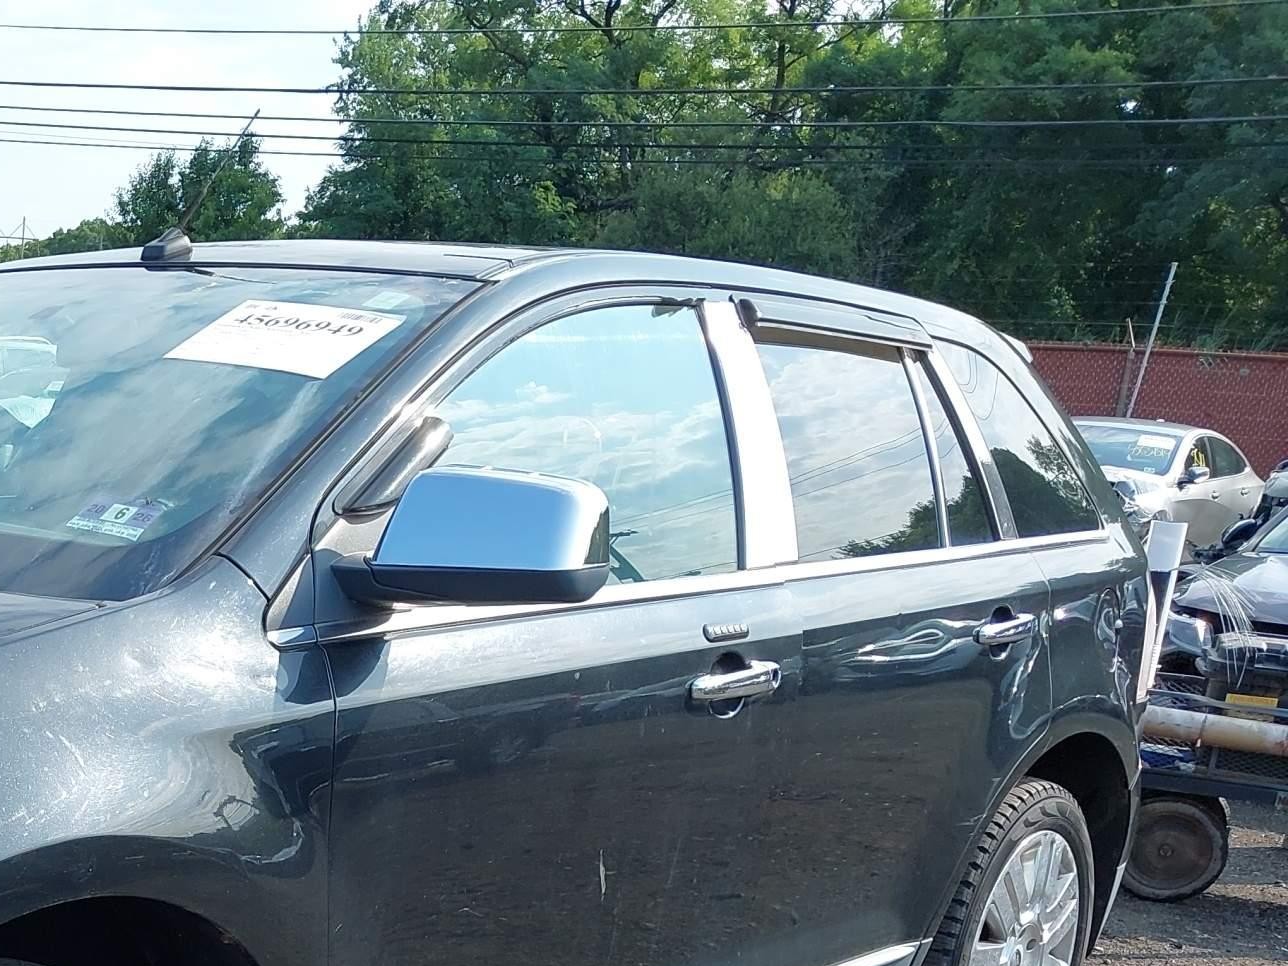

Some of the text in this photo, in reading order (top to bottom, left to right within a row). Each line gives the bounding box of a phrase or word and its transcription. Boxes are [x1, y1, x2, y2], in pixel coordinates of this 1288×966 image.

[233, 313, 365, 337] 45696949
[88, 504, 106, 514] 20
[114, 507, 130, 520] 6
